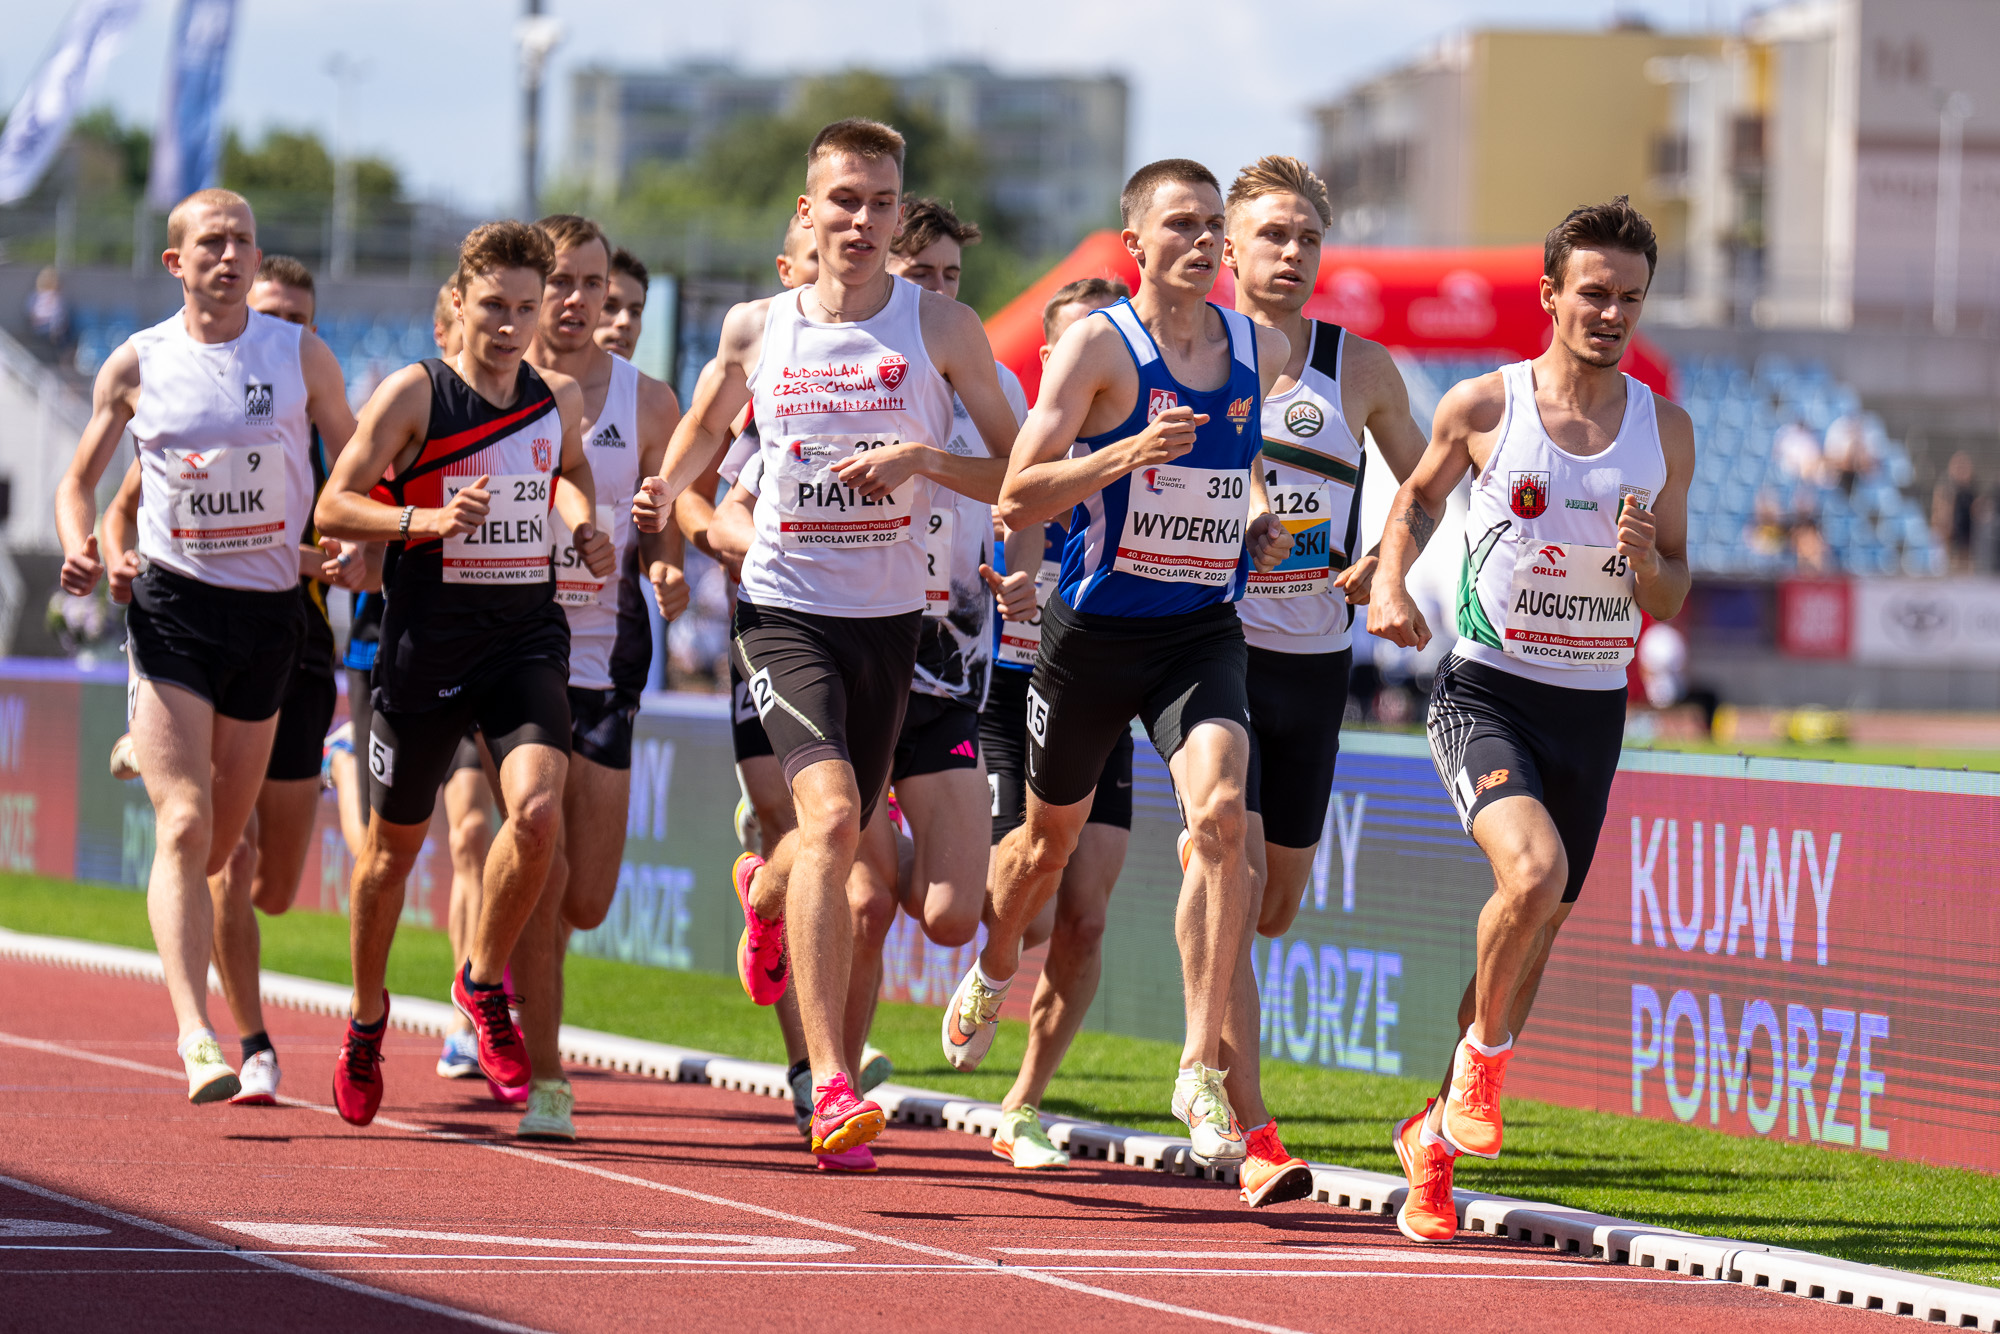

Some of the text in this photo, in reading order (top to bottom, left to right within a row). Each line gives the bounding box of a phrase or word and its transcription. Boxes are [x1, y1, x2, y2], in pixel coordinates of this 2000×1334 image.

[773, 376, 876, 396] CZĘSTOCHOWA
[1227, 395, 1253, 416] AWF
[1290, 406, 1317, 421] RKS
[592, 439, 626, 448] adidas
[247, 452, 261, 472] 9
[180, 472, 208, 480] ORLEN
[1156, 481, 1186, 489] POMORZE
[513, 481, 546, 501] 236
[1206, 476, 1243, 499] 310
[190, 488, 264, 516] KULIK
[1273, 491, 1319, 514] 126
[802, 523, 820, 531] PZLA
[821, 522, 867, 531] Mistrzostwa
[868, 521, 890, 529] Polski
[1133, 511, 1240, 544] WYDERKA
[185, 535, 273, 550] WŁOCŁAWEK 2023
[797, 532, 897, 544] WŁOCŁAWEK 2023
[483, 559, 525, 567] Mistrzostwa
[1127, 551, 1139, 559] 40.
[1140, 553, 1159, 562] PZLA
[1160, 556, 1203, 566] Mistrzostwa
[1203, 560, 1224, 568] Polski
[1602, 555, 1627, 577] 45
[459, 570, 527, 579] WŁOCŁAWEK
[1132, 563, 1227, 581] WŁOCŁAWEK 2023
[1248, 571, 1322, 582] strzostwa Polski U23
[1532, 566, 1567, 578] ORLEN
[1244, 583, 1313, 594] ŁAWEK 2023
[1514, 588, 1633, 622] AUGUSTYNIAK
[1515, 631, 1528, 639] 40.
[1529, 633, 1548, 643] PZLA
[1549, 637, 1594, 646] Mistrzostwa
[1522, 644, 1619, 660] WŁOCŁAWEK 2023
[754, 677, 772, 711] 2
[1027, 694, 1046, 736] 15
[372, 740, 385, 776] 5
[1631, 816, 1842, 966] KUJAWY
[1251, 937, 1400, 1076] MORZE
[1631, 984, 1890, 1151] POMORZE
